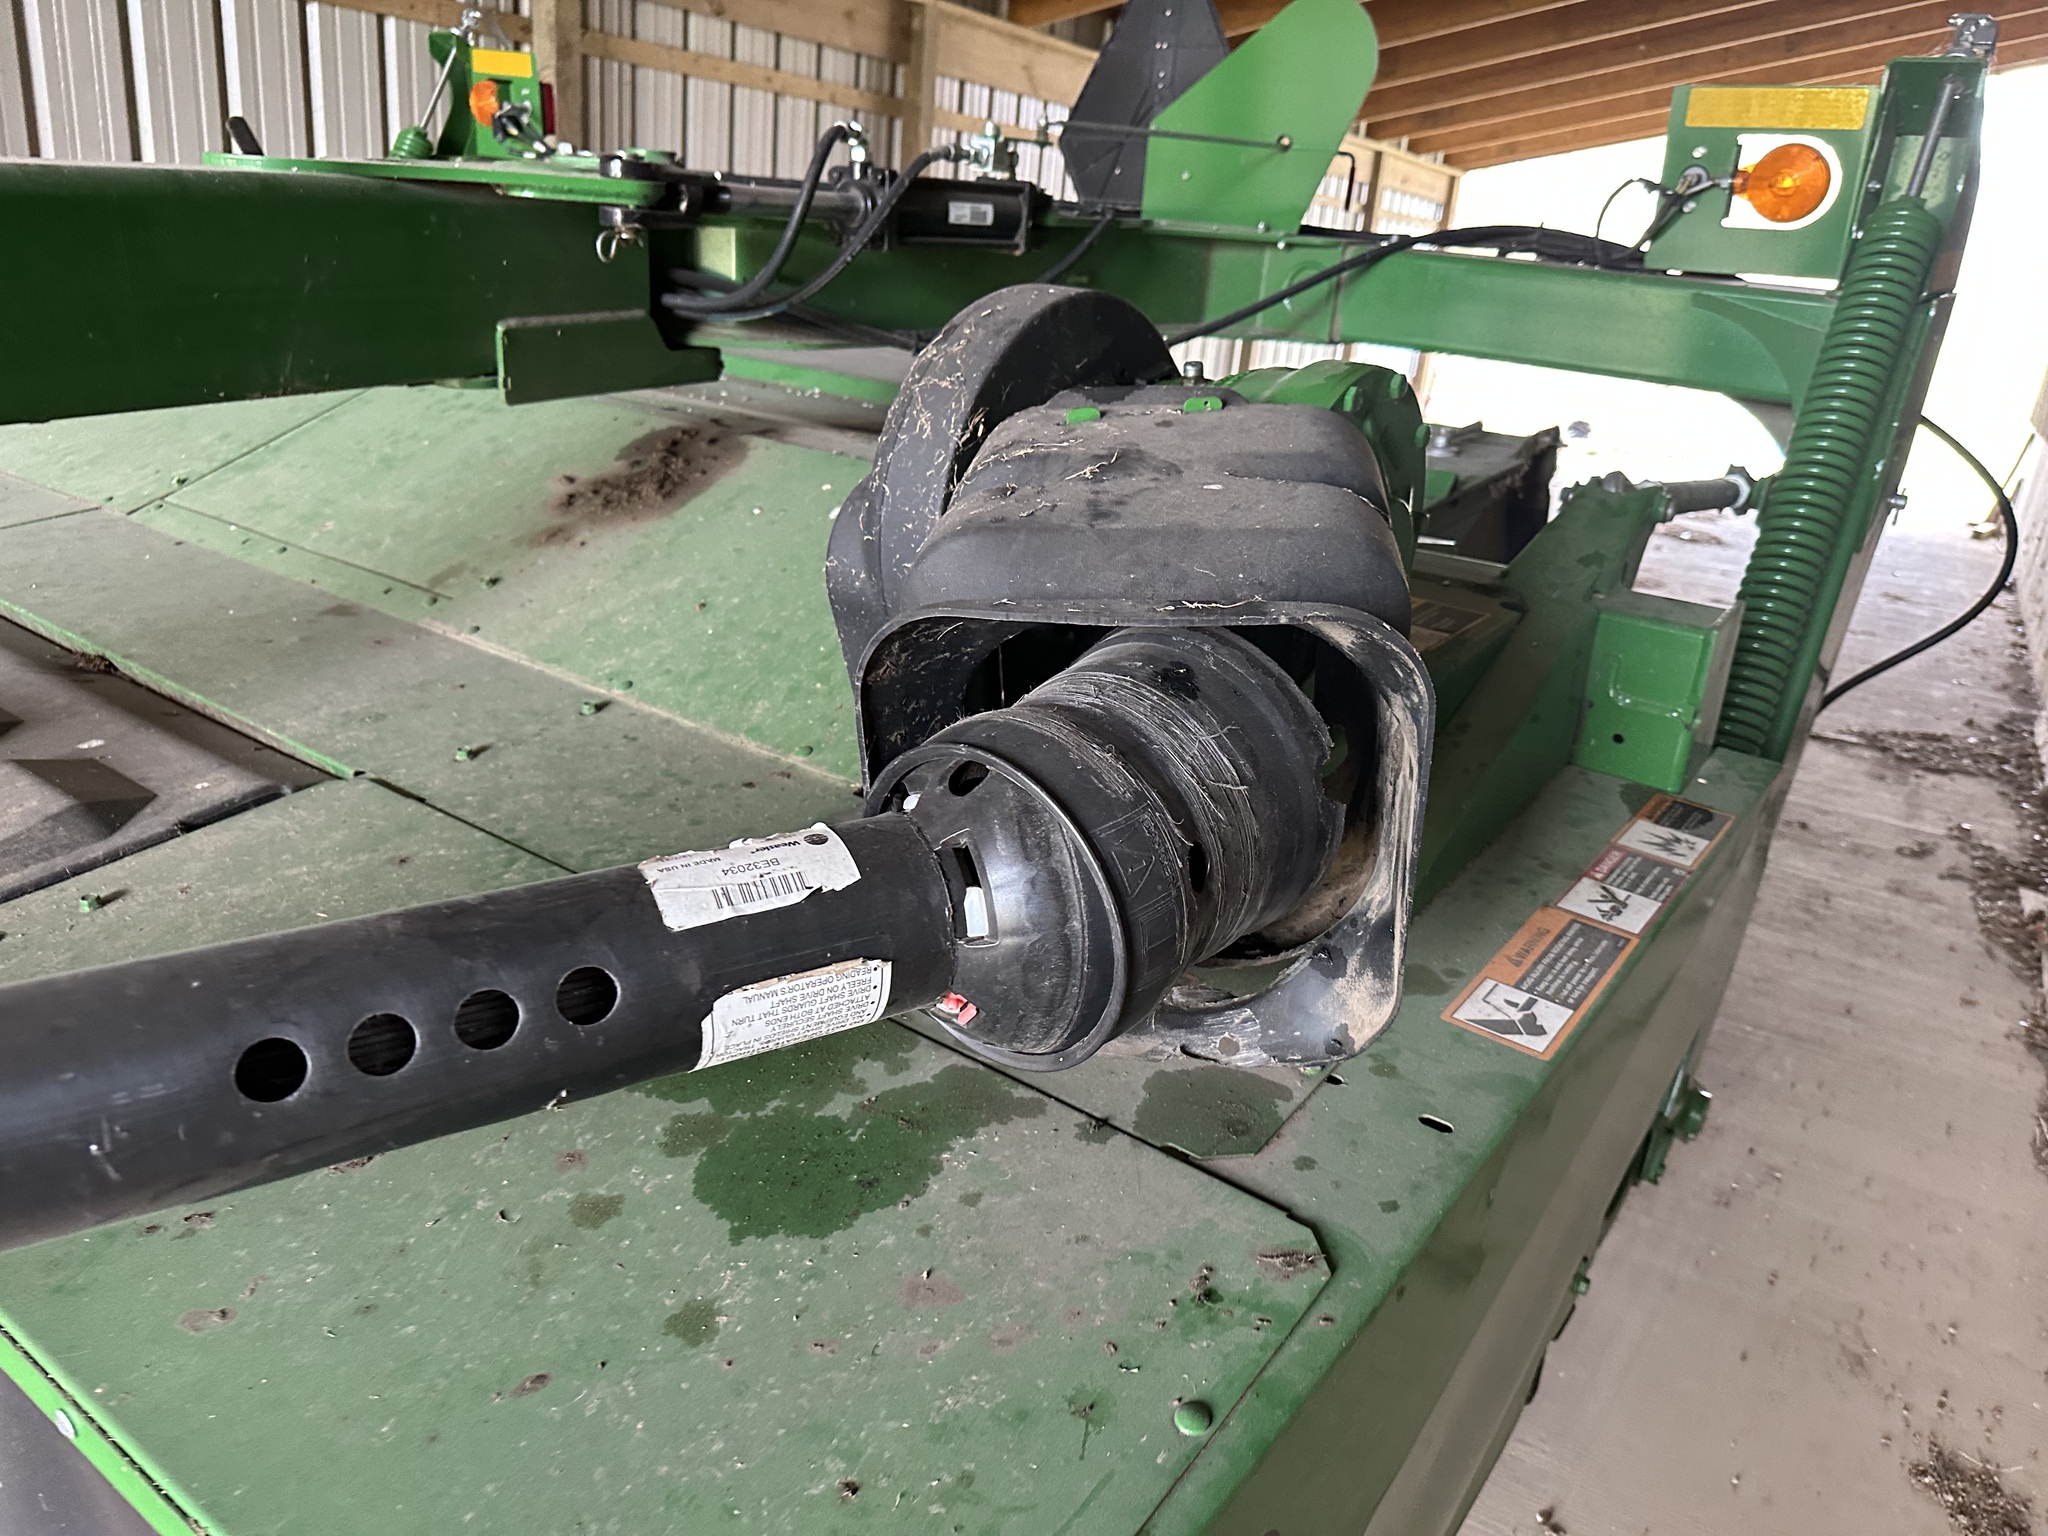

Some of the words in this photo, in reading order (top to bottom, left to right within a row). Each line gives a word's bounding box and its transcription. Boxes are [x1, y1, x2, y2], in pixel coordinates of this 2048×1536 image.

[692, 857, 721, 866] MADE
[722, 858, 780, 876] BE32034
[657, 865, 679, 873] USA
[1514, 927, 1551, 960] WARNING
[835, 966, 871, 981] READING
[780, 975, 834, 996] OPERATOR'S
[827, 985, 839, 994] ON
[840, 977, 871, 990] FREELY
[742, 990, 778, 1004] MANUAL
[799, 991, 824, 1001] DRIVE
[848, 985, 871, 997] DRIVE
[770, 996, 797, 1009] SHAFT
[819, 992, 845, 1005] SHAFT
[827, 994, 870, 1010] ATTACHED
[782, 999, 817, 1014] GUARDS
[815, 1005, 825, 1014] AT
[845, 1001, 869, 1012] DRIVE
[757, 1009, 779, 1020] THAT
[789, 1009, 813, 1020] BOTH
[817, 1008, 843, 1020] SHAFT
[851, 1014, 865, 1022] ALL
[732, 1015, 755, 1027] TURN
[765, 1016, 788, 1027] ENDS
[770, 1018, 815, 1032] SECURELY
[802, 1013, 848, 1031] EQUIPMENT
[827, 1018, 849, 1027] DRIVE
[764, 1027, 799, 1039] SHIELDS
[797, 1025, 823, 1035] SHAFT
[724, 1040, 751, 1050] PLACE
